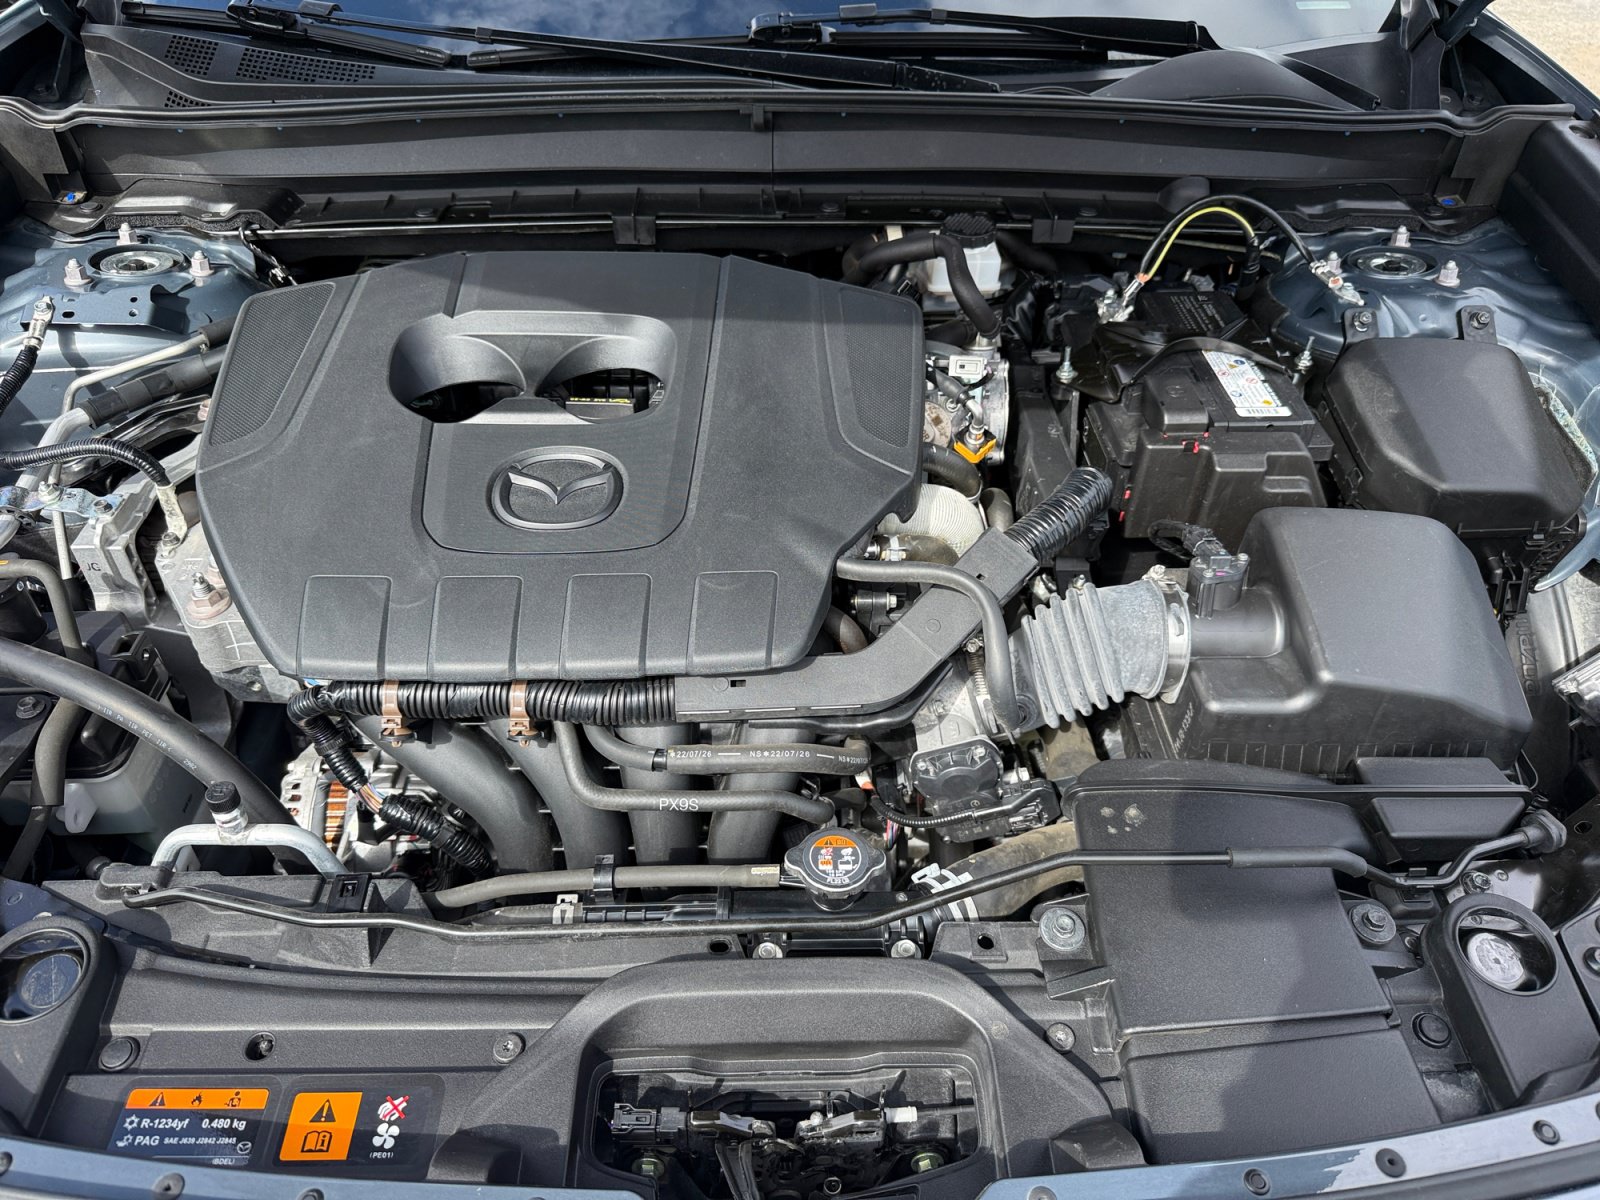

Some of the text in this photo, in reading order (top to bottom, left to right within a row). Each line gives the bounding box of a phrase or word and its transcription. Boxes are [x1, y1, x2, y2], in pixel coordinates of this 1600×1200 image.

[658, 797, 699, 811] PX9S
[140, 1118, 247, 1131] R-1234yf 0.480 kg
[134, 1135, 160, 1146] PAG
